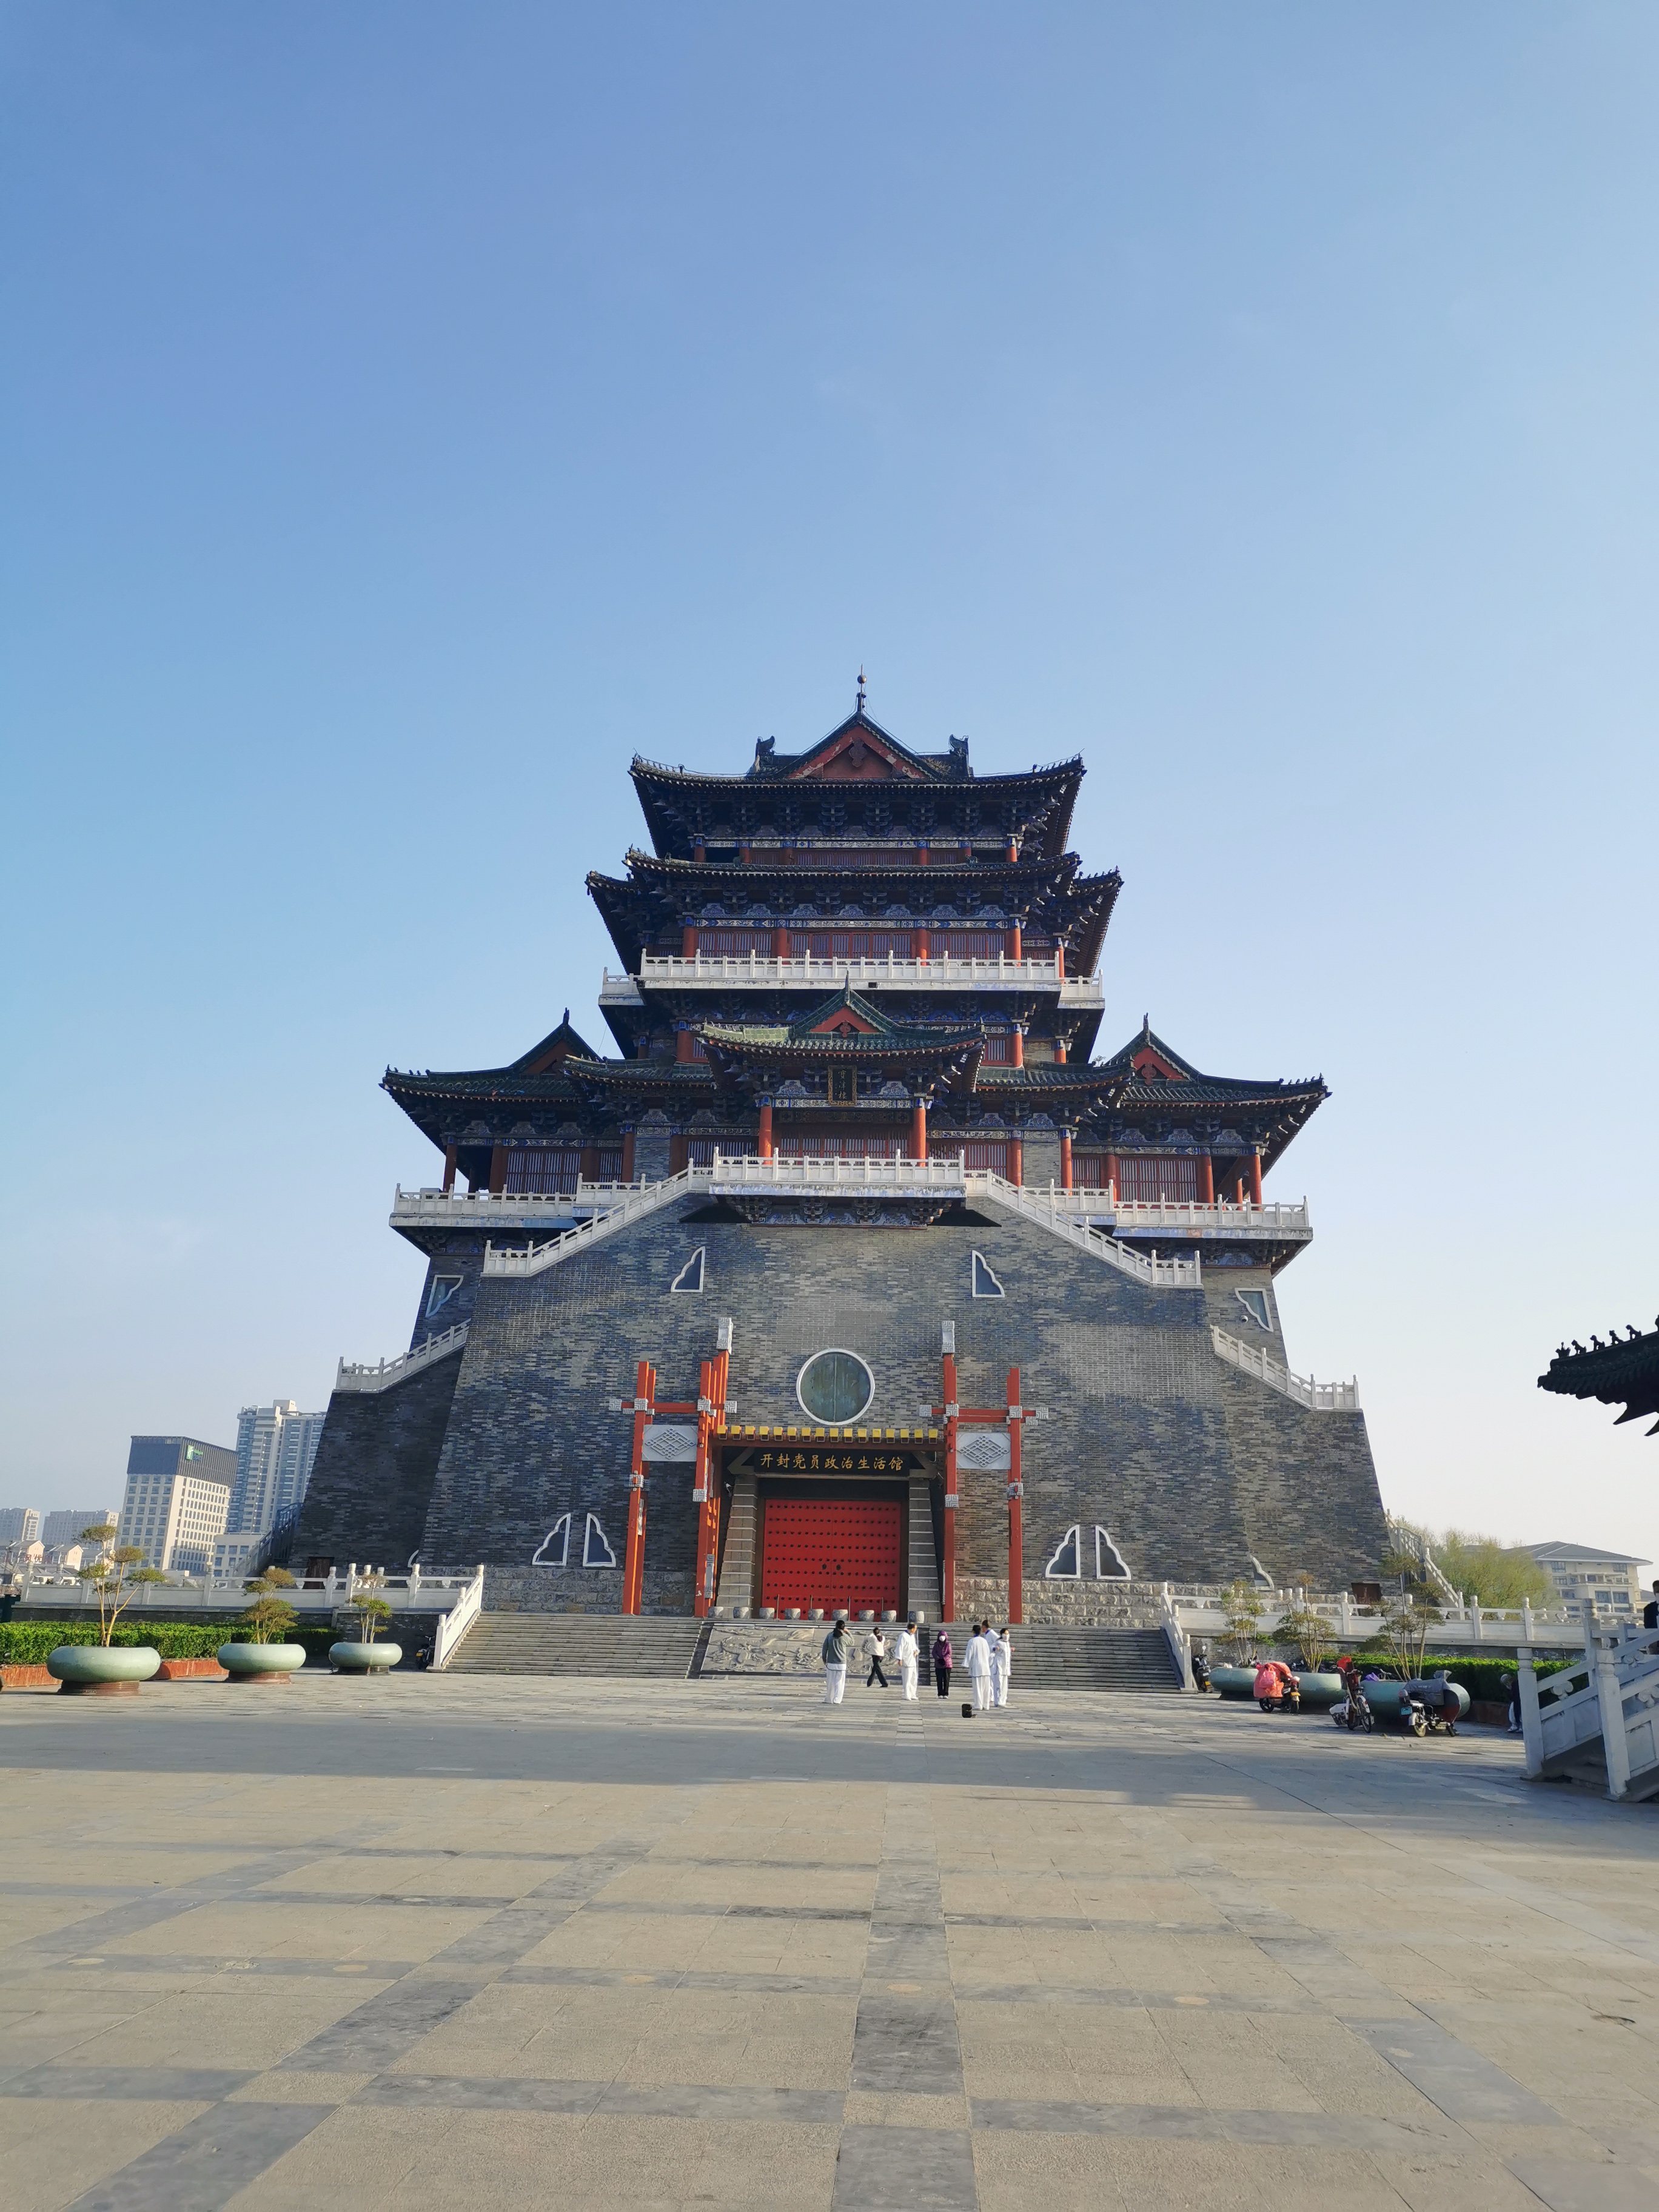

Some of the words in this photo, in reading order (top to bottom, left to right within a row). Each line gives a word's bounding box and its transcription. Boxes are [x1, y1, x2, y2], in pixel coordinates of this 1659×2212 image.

[760, 1453, 903, 1471] 开封党员政治生活馆
